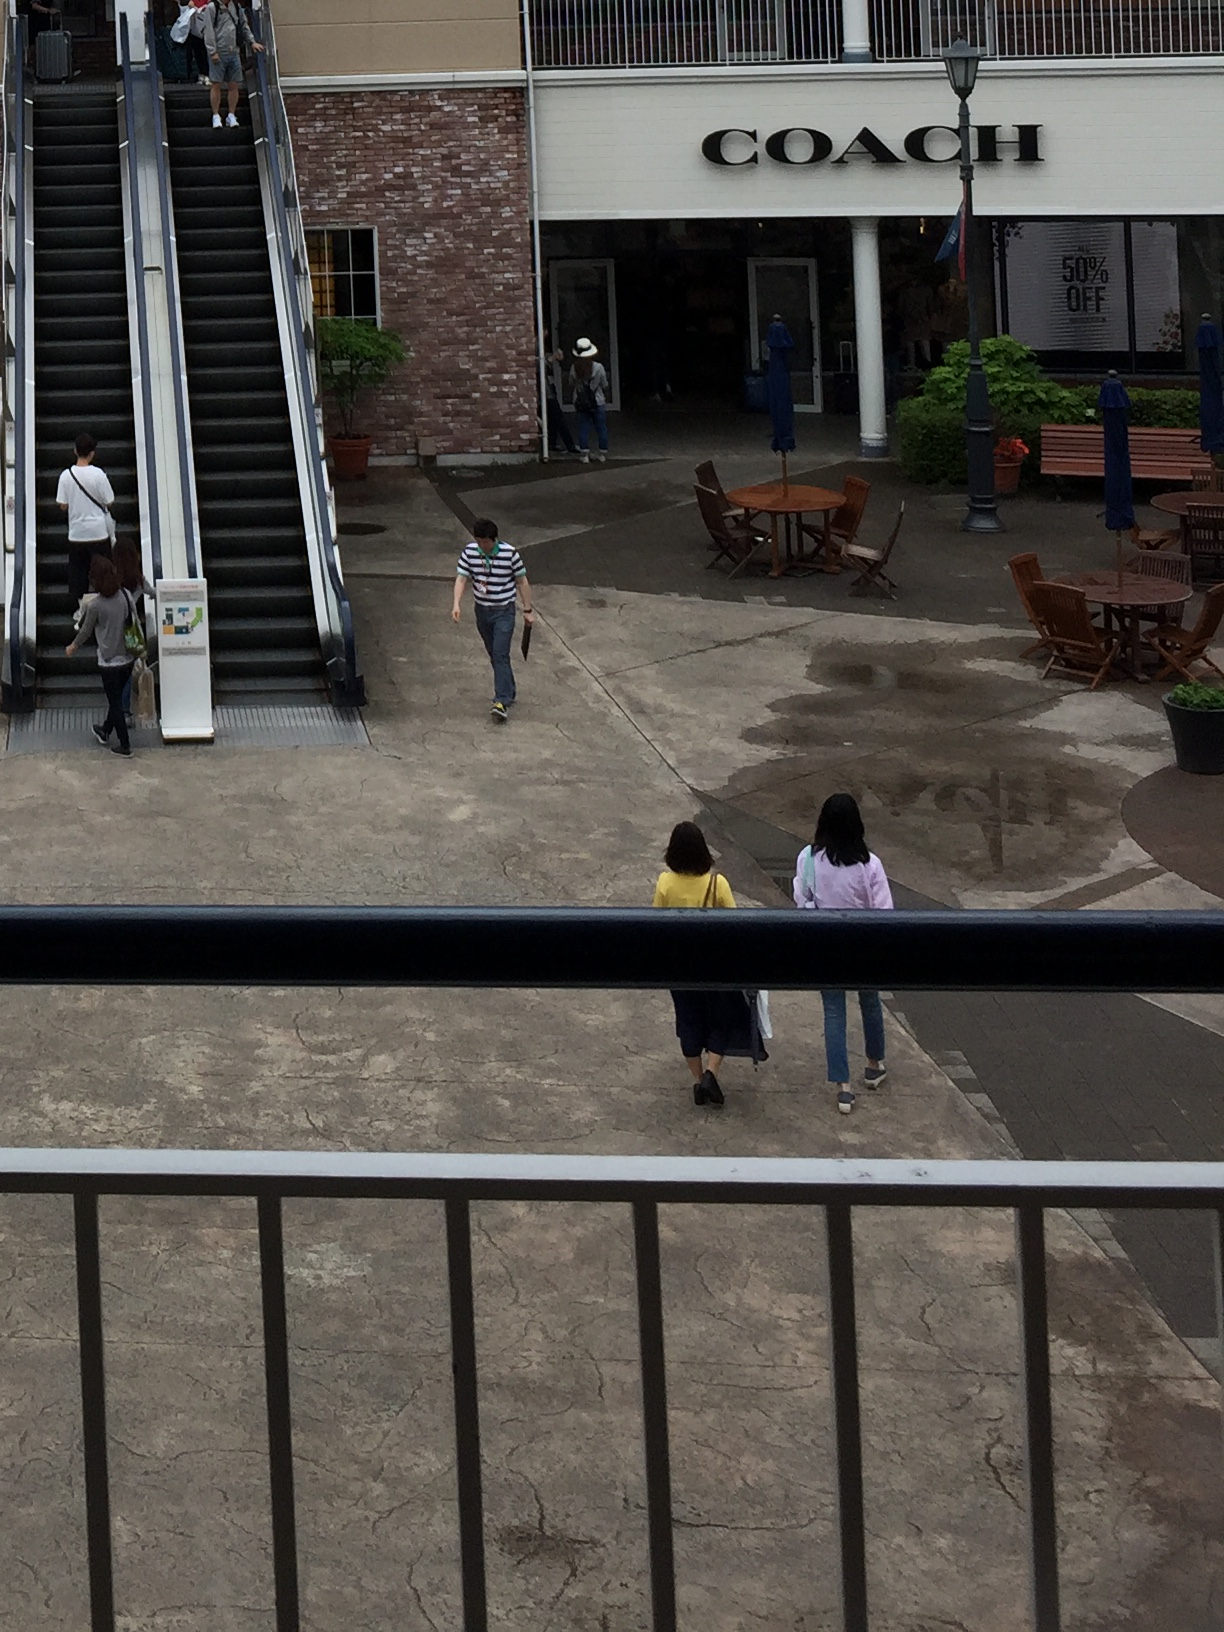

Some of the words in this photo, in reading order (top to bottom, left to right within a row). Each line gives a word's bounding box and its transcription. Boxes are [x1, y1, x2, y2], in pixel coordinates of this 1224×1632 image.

[701, 124, 1045, 166] COACH
[1062, 256, 1109, 284] 50%
[1066, 285, 1107, 313] OFF
